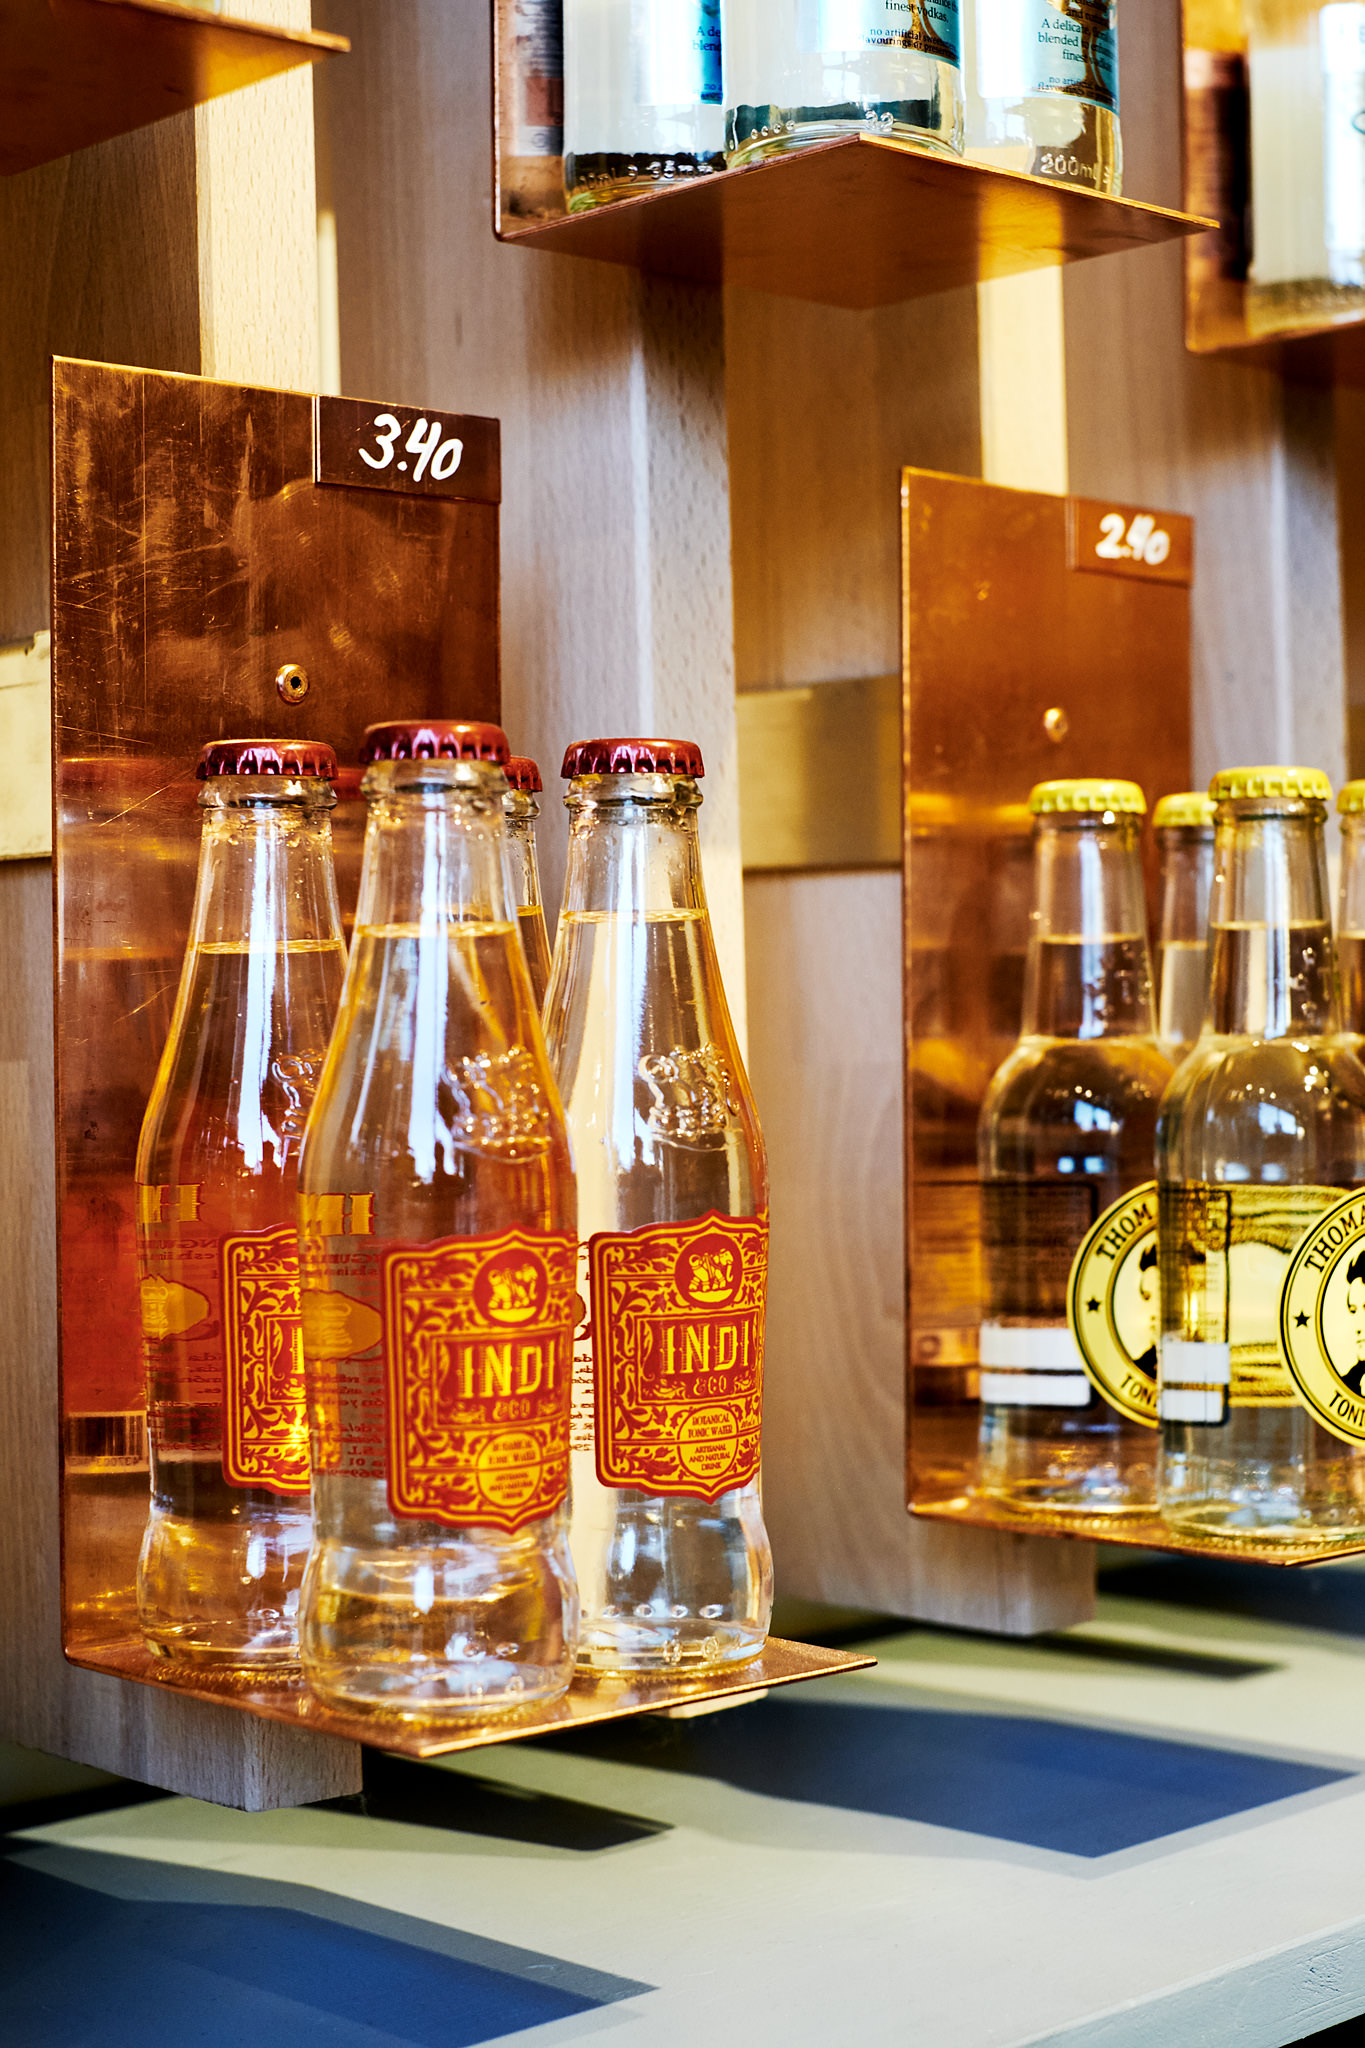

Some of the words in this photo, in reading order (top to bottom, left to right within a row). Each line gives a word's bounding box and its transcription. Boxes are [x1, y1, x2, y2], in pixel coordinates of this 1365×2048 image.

[885, 0, 914, 13] finest
[1037, 31, 1079, 47] blended
[358, 413, 464, 483] 3.40
[662, 1320, 750, 1375] INDI
[462, 1340, 558, 1399] INDI
[711, 1424, 733, 1435] WATER
